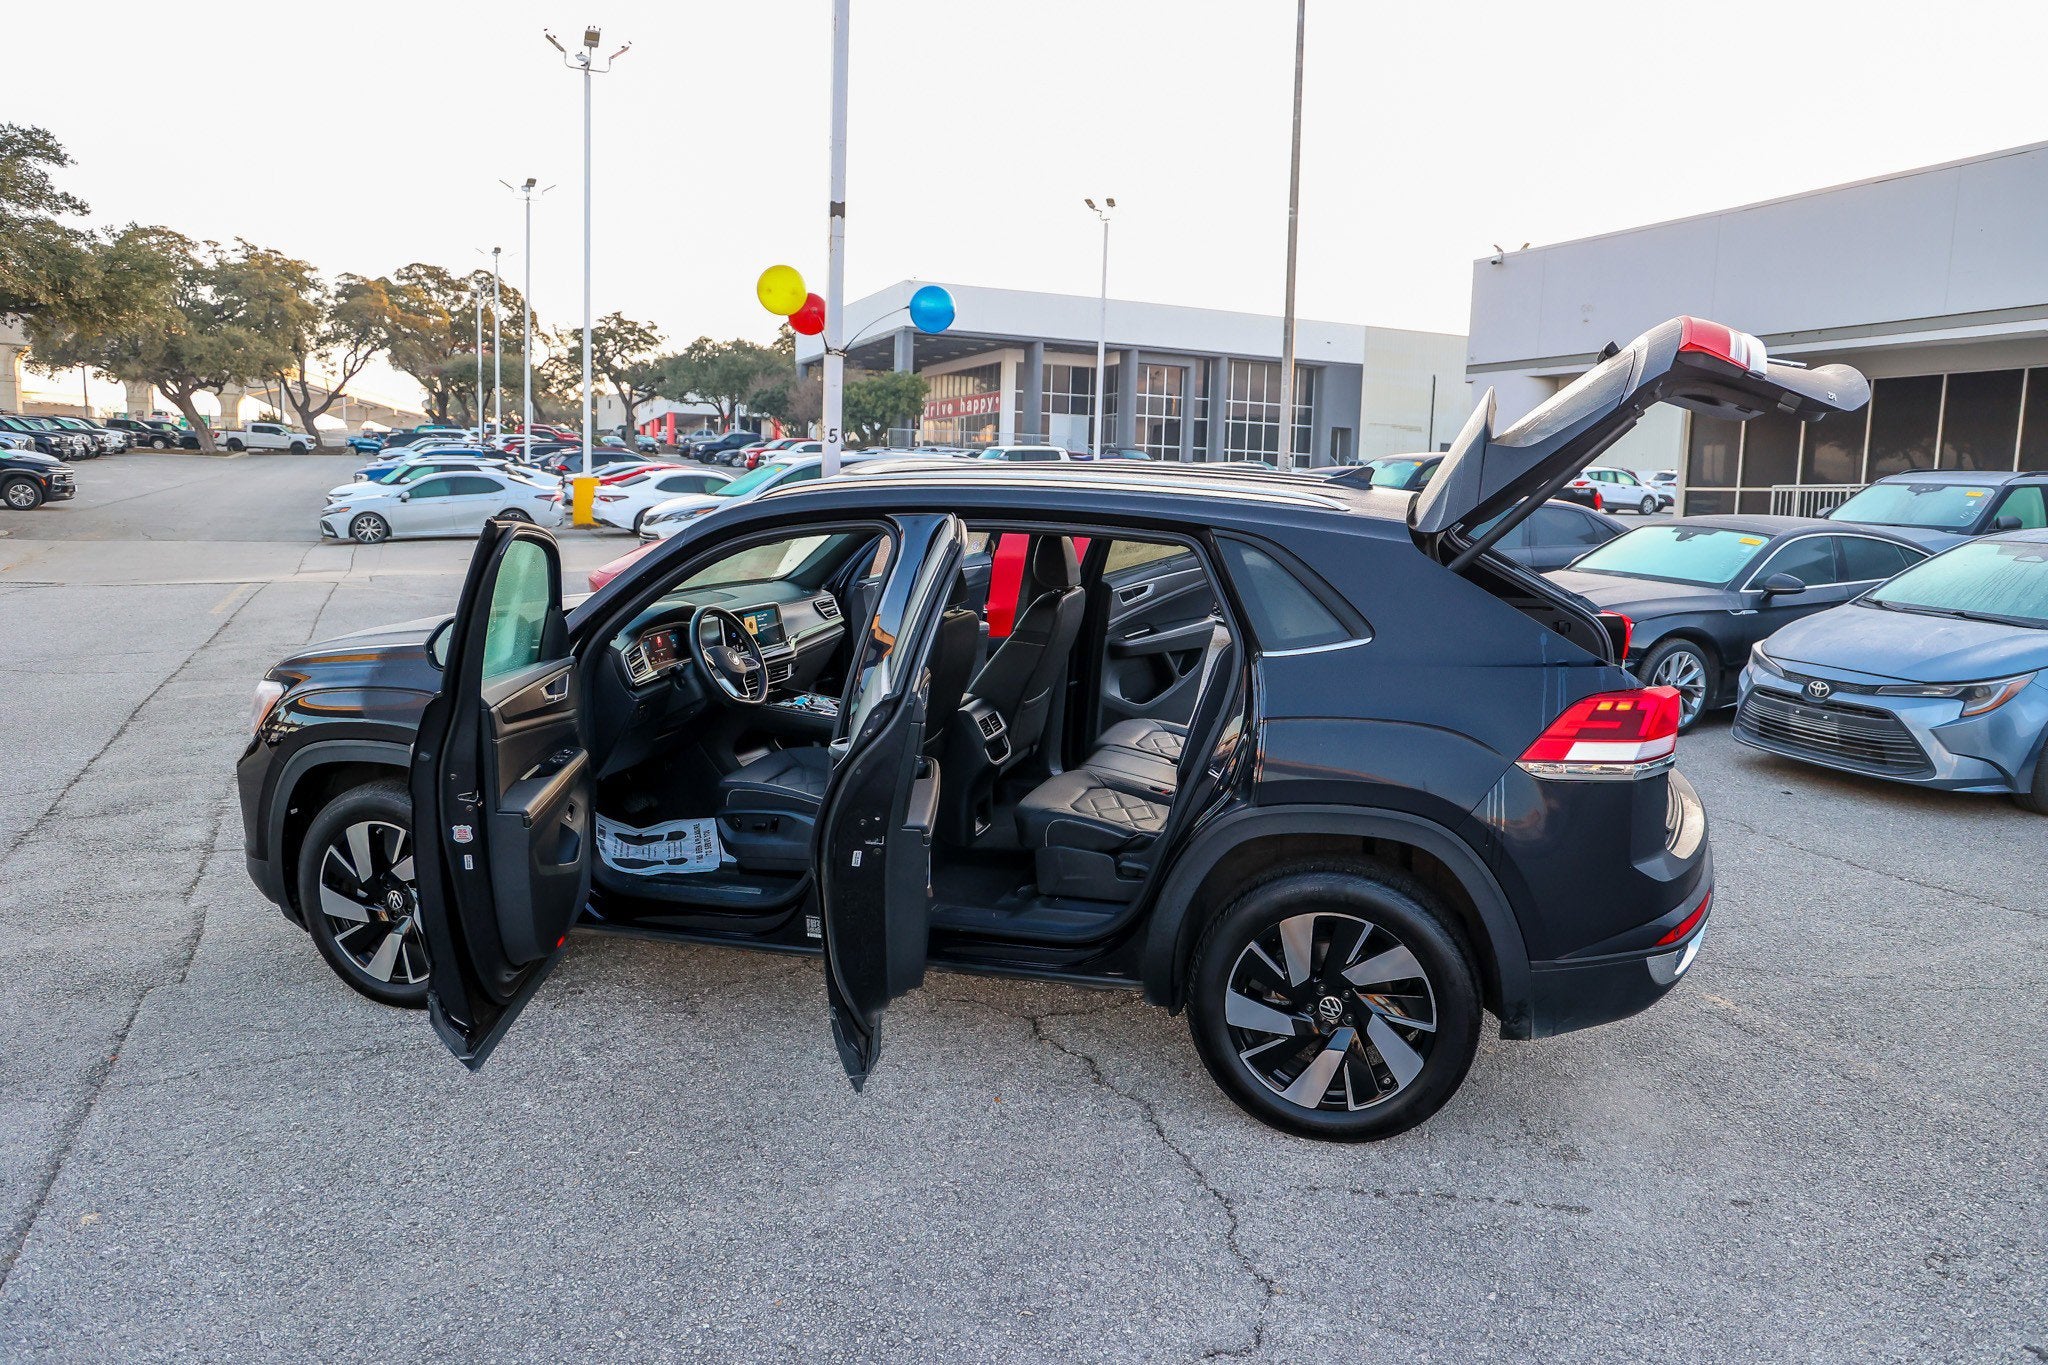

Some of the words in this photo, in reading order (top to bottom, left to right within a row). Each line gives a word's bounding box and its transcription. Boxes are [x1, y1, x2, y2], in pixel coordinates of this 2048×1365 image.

[924, 402, 953, 417] drive
[960, 397, 993, 414] happy
[828, 428, 838, 443] 5
